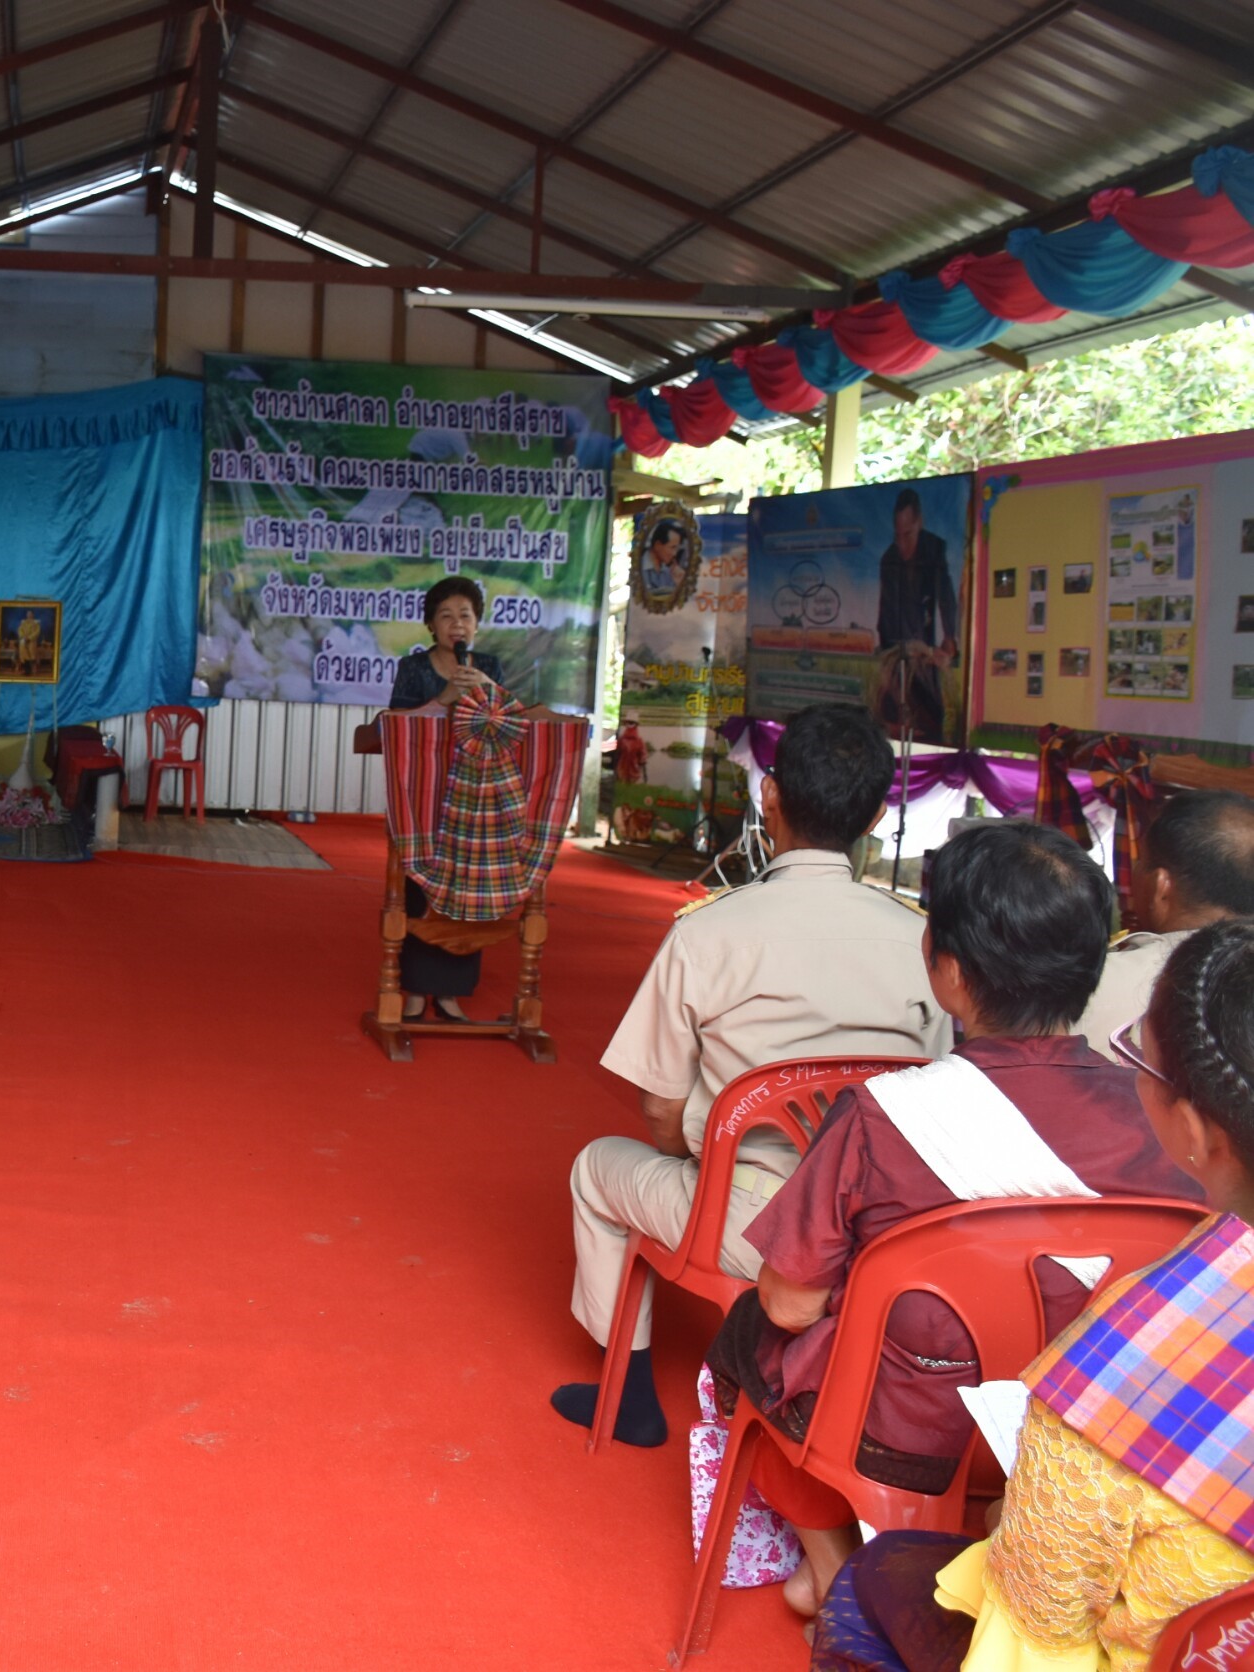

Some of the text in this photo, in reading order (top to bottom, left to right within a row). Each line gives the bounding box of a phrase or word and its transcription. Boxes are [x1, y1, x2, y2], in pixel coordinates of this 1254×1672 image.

[254, 380, 564, 448] ชาวบ้านศาลา อำเภอยางสีสุราช
[210, 437, 605, 512] ขอต้อนรับ คณะกรรมการคัดสรรหมู่บ้าน
[245, 509, 565, 577] เศรษฐกิจพอเพียง อยู่เย็นเป็นสุข
[263, 573, 542, 625] จังหวัดมหาสารค 2560
[315, 639, 395, 684] ด้วยควา
